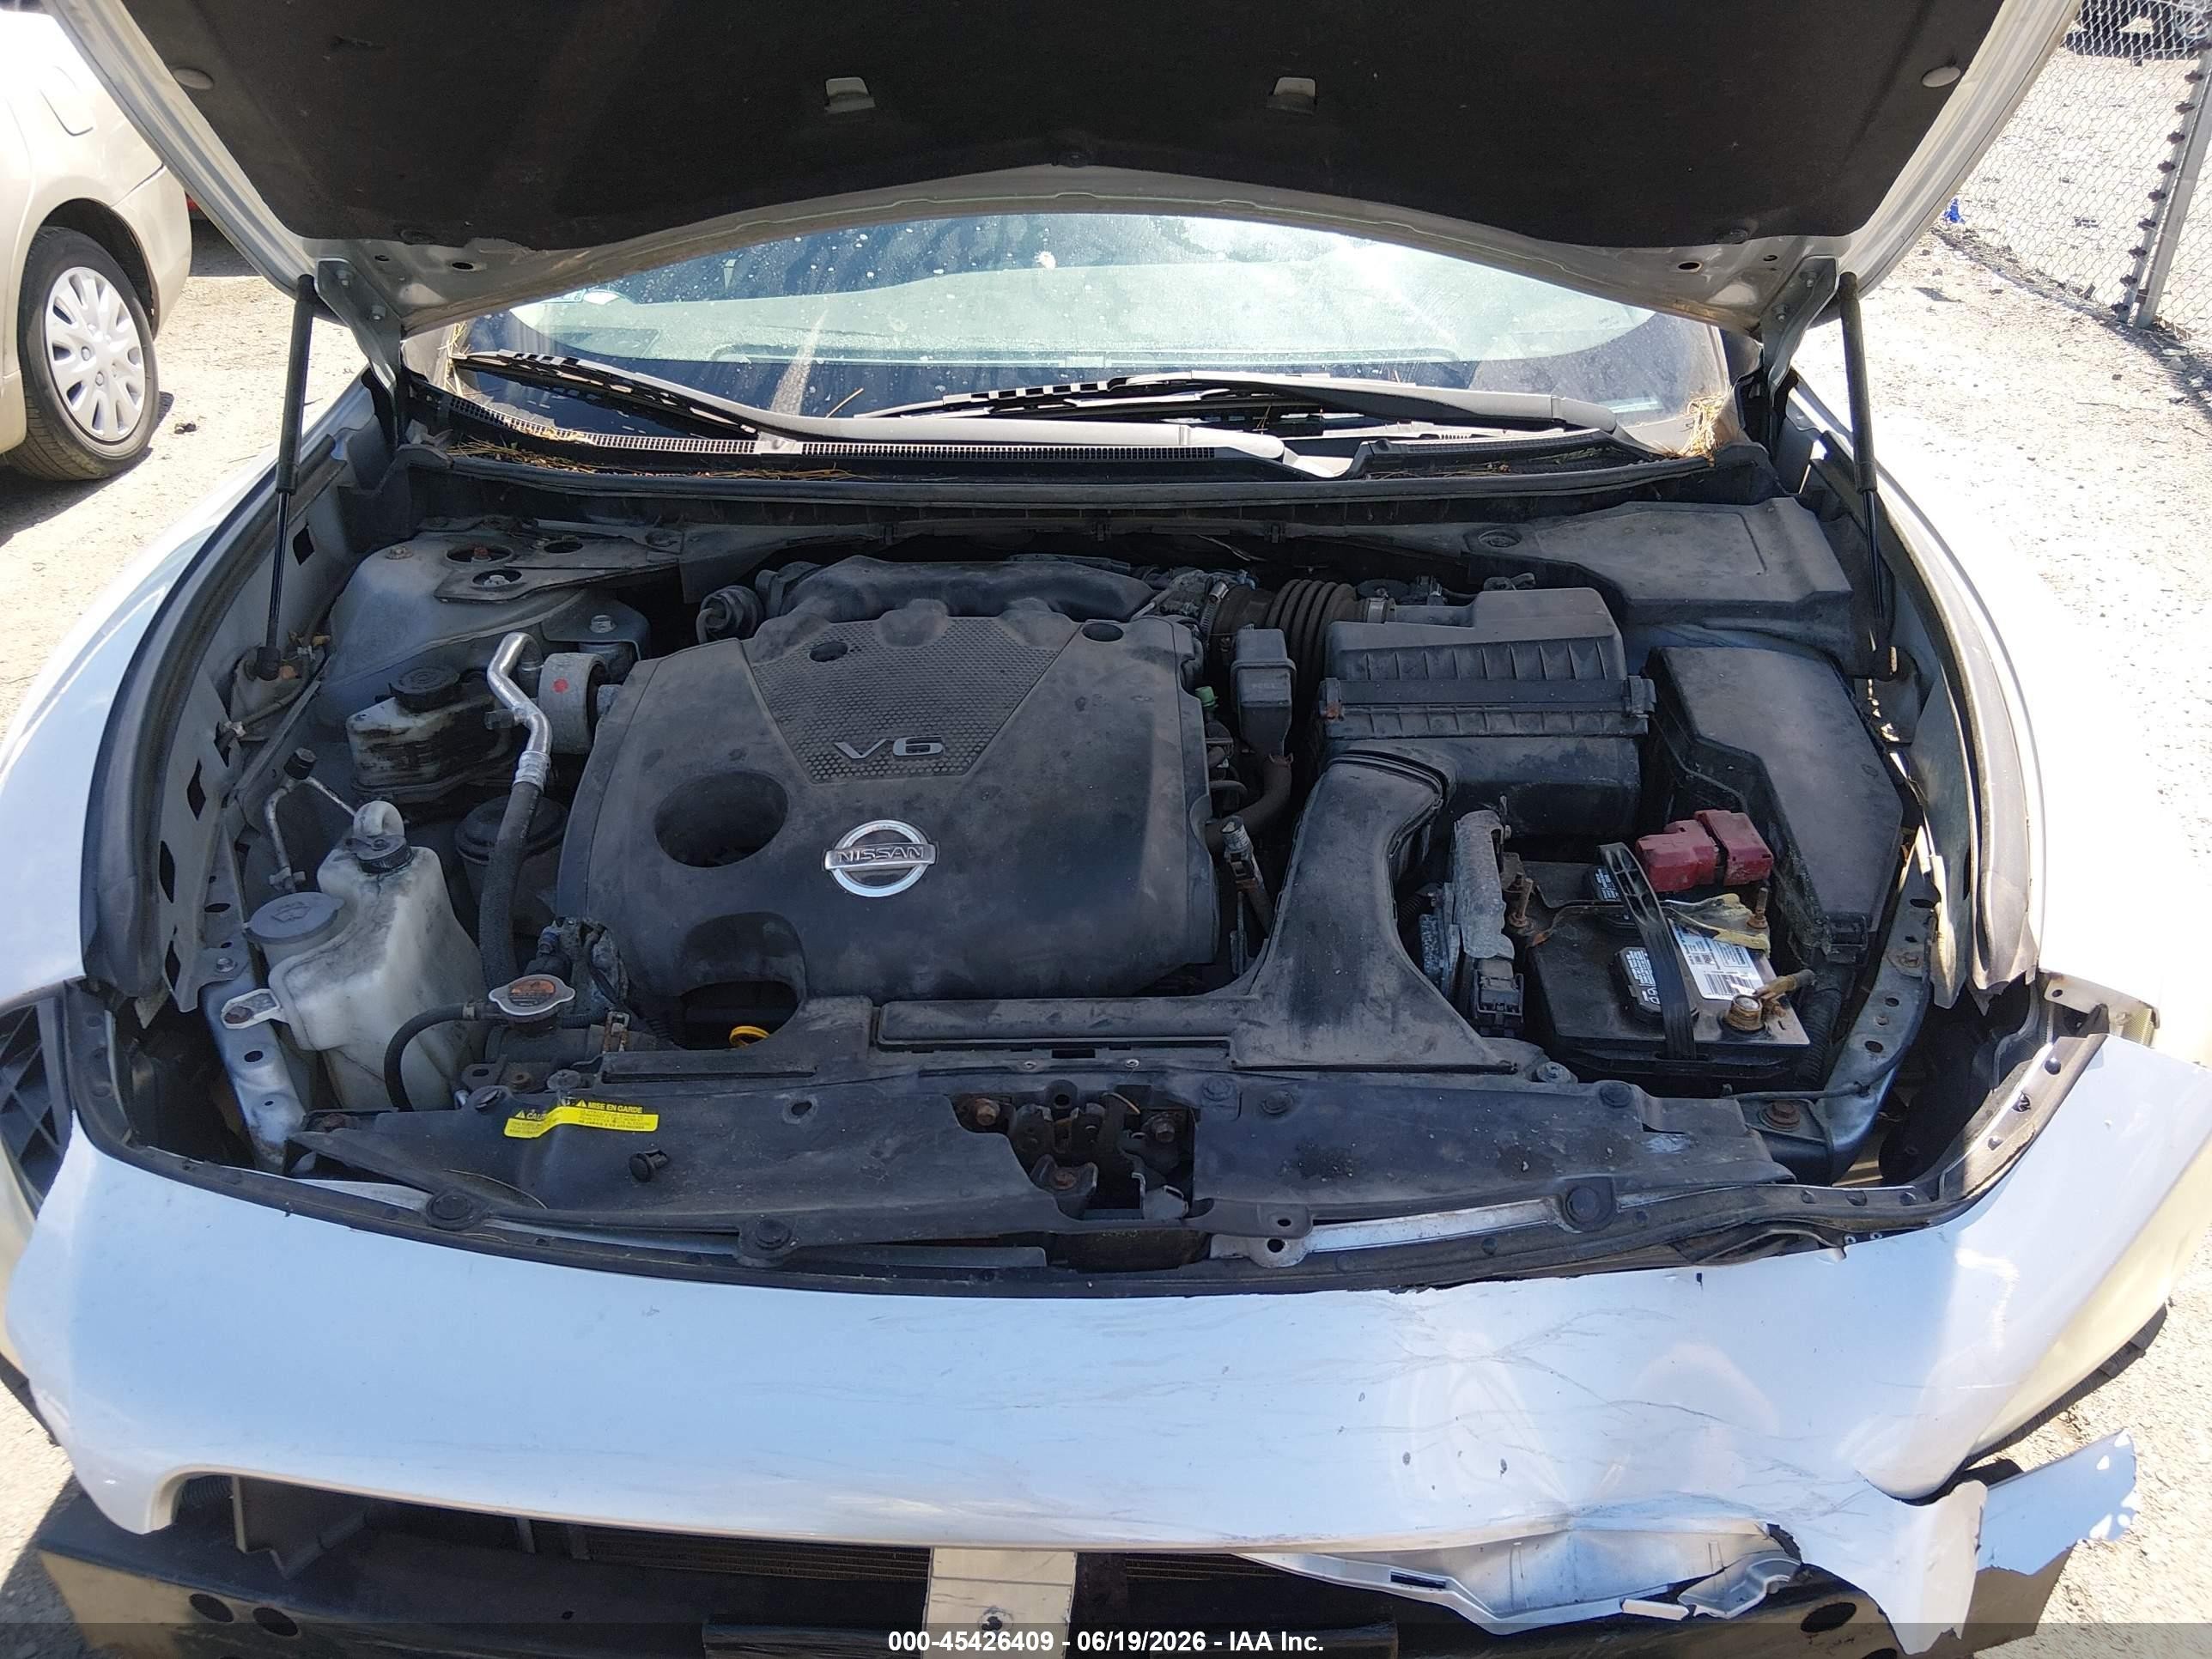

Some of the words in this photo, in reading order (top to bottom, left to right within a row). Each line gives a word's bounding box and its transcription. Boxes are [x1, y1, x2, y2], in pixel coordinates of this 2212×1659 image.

[834, 735, 944, 759] V6
[837, 846, 924, 863] NISSAN
[588, 1102, 605, 1110] MISE
[617, 1105, 643, 1114] GARDE
